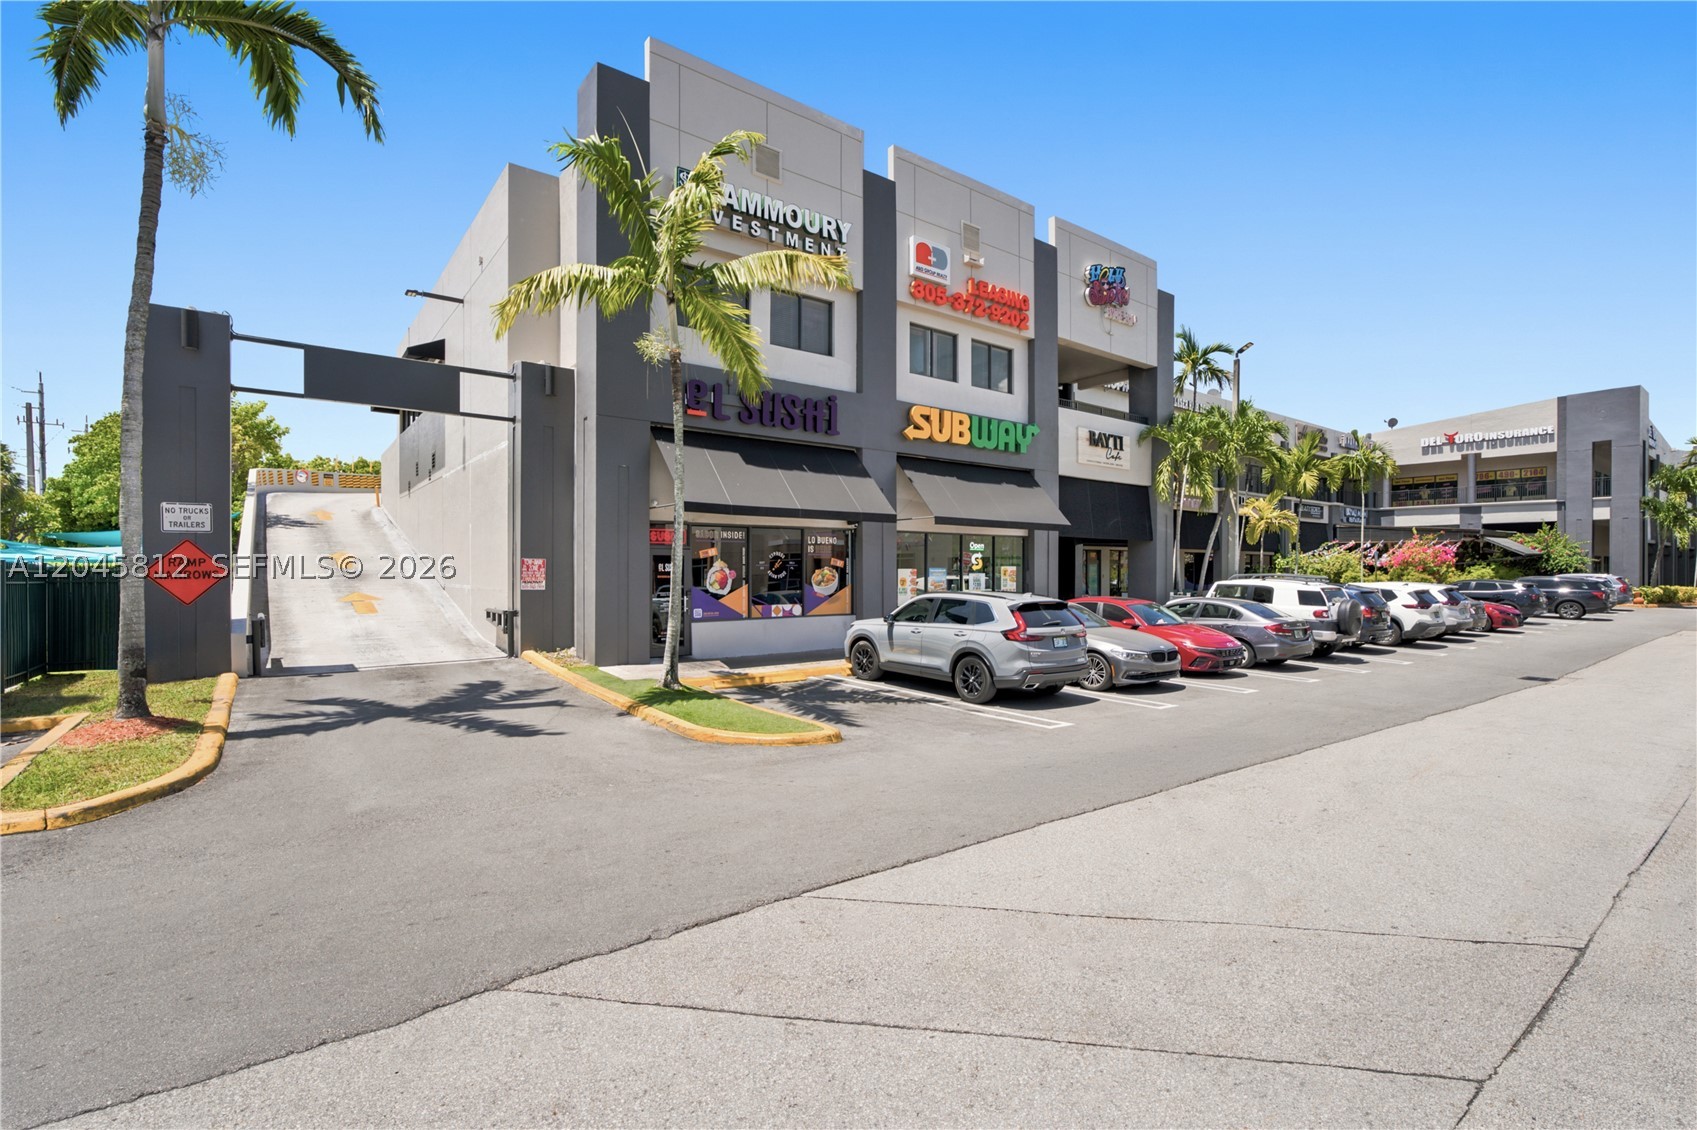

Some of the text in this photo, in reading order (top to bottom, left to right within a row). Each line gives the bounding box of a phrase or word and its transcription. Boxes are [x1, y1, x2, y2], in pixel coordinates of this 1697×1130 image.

[722, 183, 852, 244] AMMOURY
[699, 204, 847, 256] VESTMENT
[967, 277, 1030, 312] LEASING
[910, 279, 1029, 331] 305-372-9202
[902, 405, 1040, 454] SUBWAY
[1421, 436, 1443, 447] DEL
[1483, 425, 1555, 441] INSURANCE
[1088, 430, 1124, 451] BAYTI
[179, 507, 209, 515] TRUCKS
[169, 521, 206, 529] TRAILERS
[720, 531, 746, 540] INSIDE!
[808, 536, 838, 545] LO BUENO
[808, 545, 815, 553] IS
[969, 541, 985, 550] Open
[168, 558, 206, 567] RAMP
